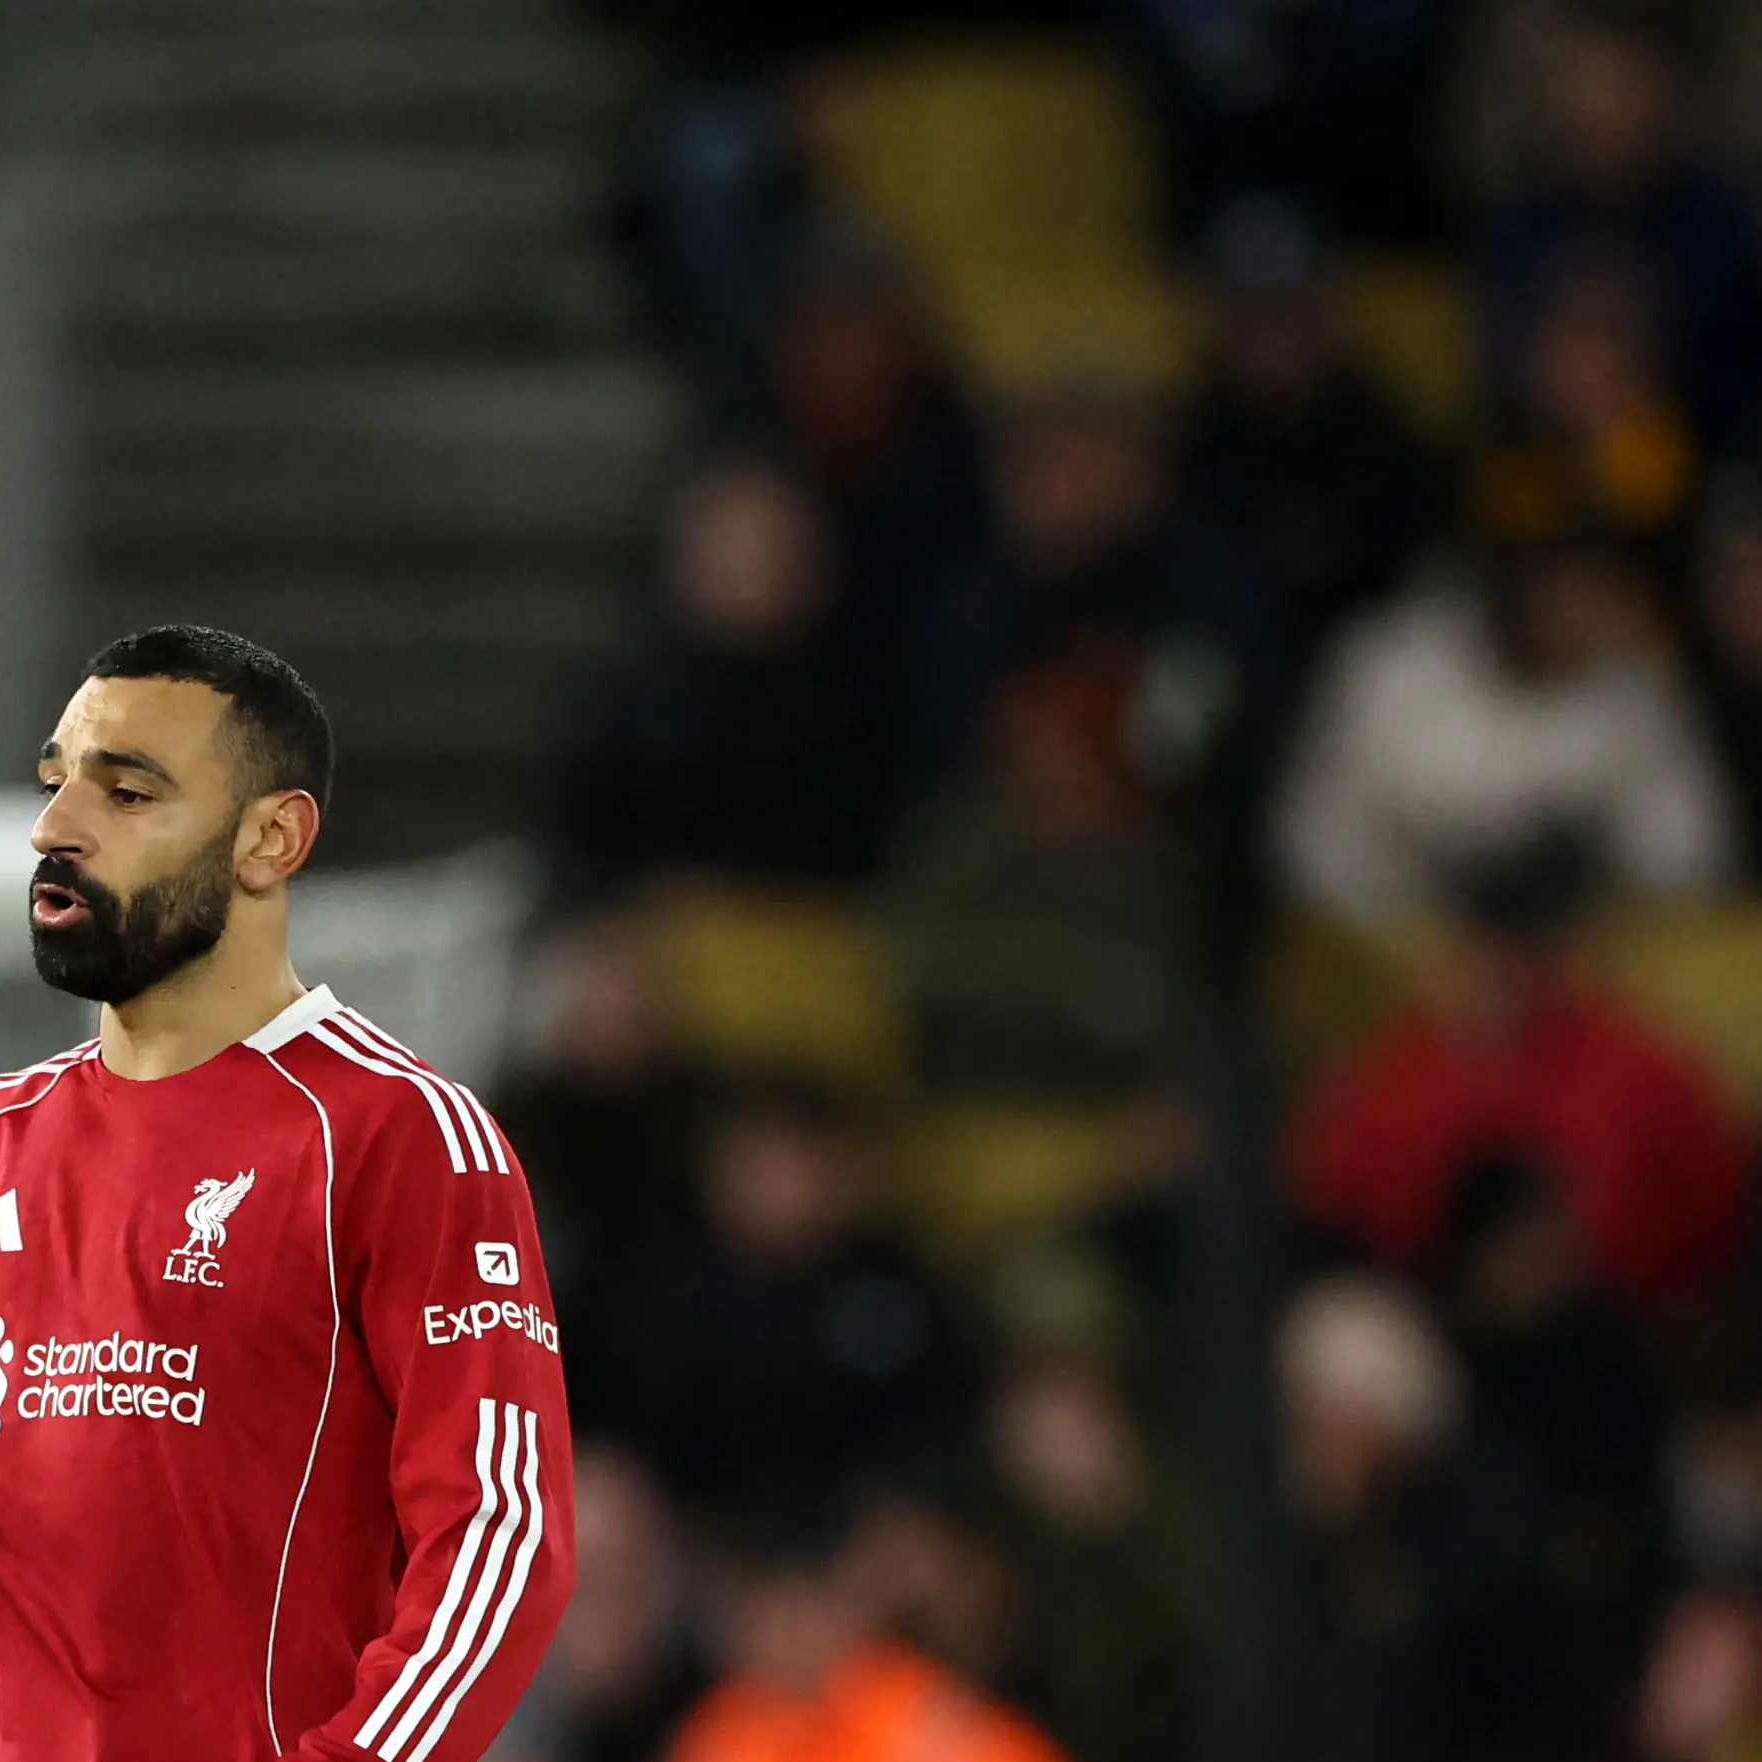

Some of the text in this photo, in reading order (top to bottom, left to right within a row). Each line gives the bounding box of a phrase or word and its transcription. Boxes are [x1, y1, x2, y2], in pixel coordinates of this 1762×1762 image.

[424, 1300, 559, 1354] Expedia
[23, 1330, 199, 1382] standard
[17, 1375, 206, 1427] chartered
